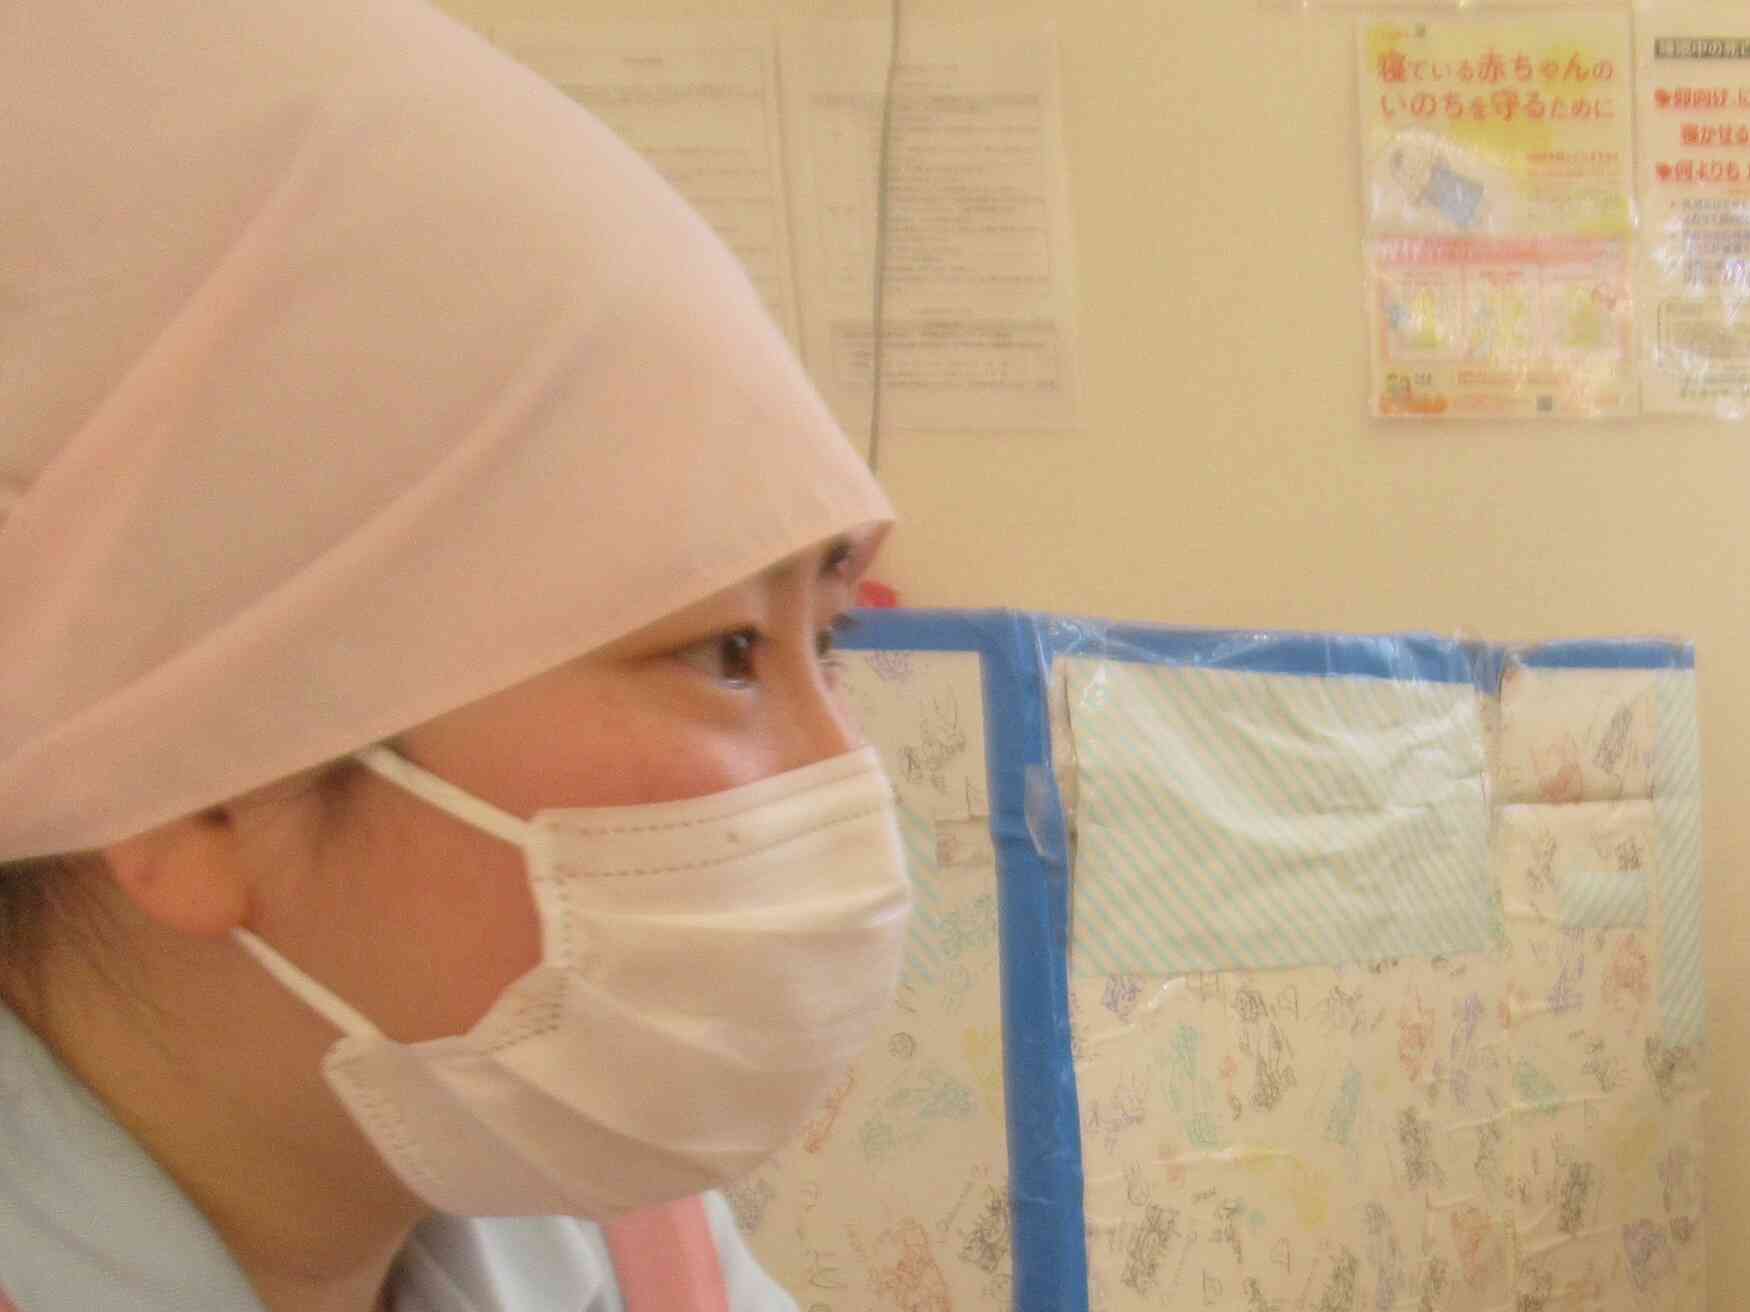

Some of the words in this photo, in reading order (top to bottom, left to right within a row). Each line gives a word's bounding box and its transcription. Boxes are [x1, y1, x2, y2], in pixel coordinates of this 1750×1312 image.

[1379, 50, 1616, 83] 寝ている赤ちゃんの
[1381, 89, 1616, 121] いのちを守るために
